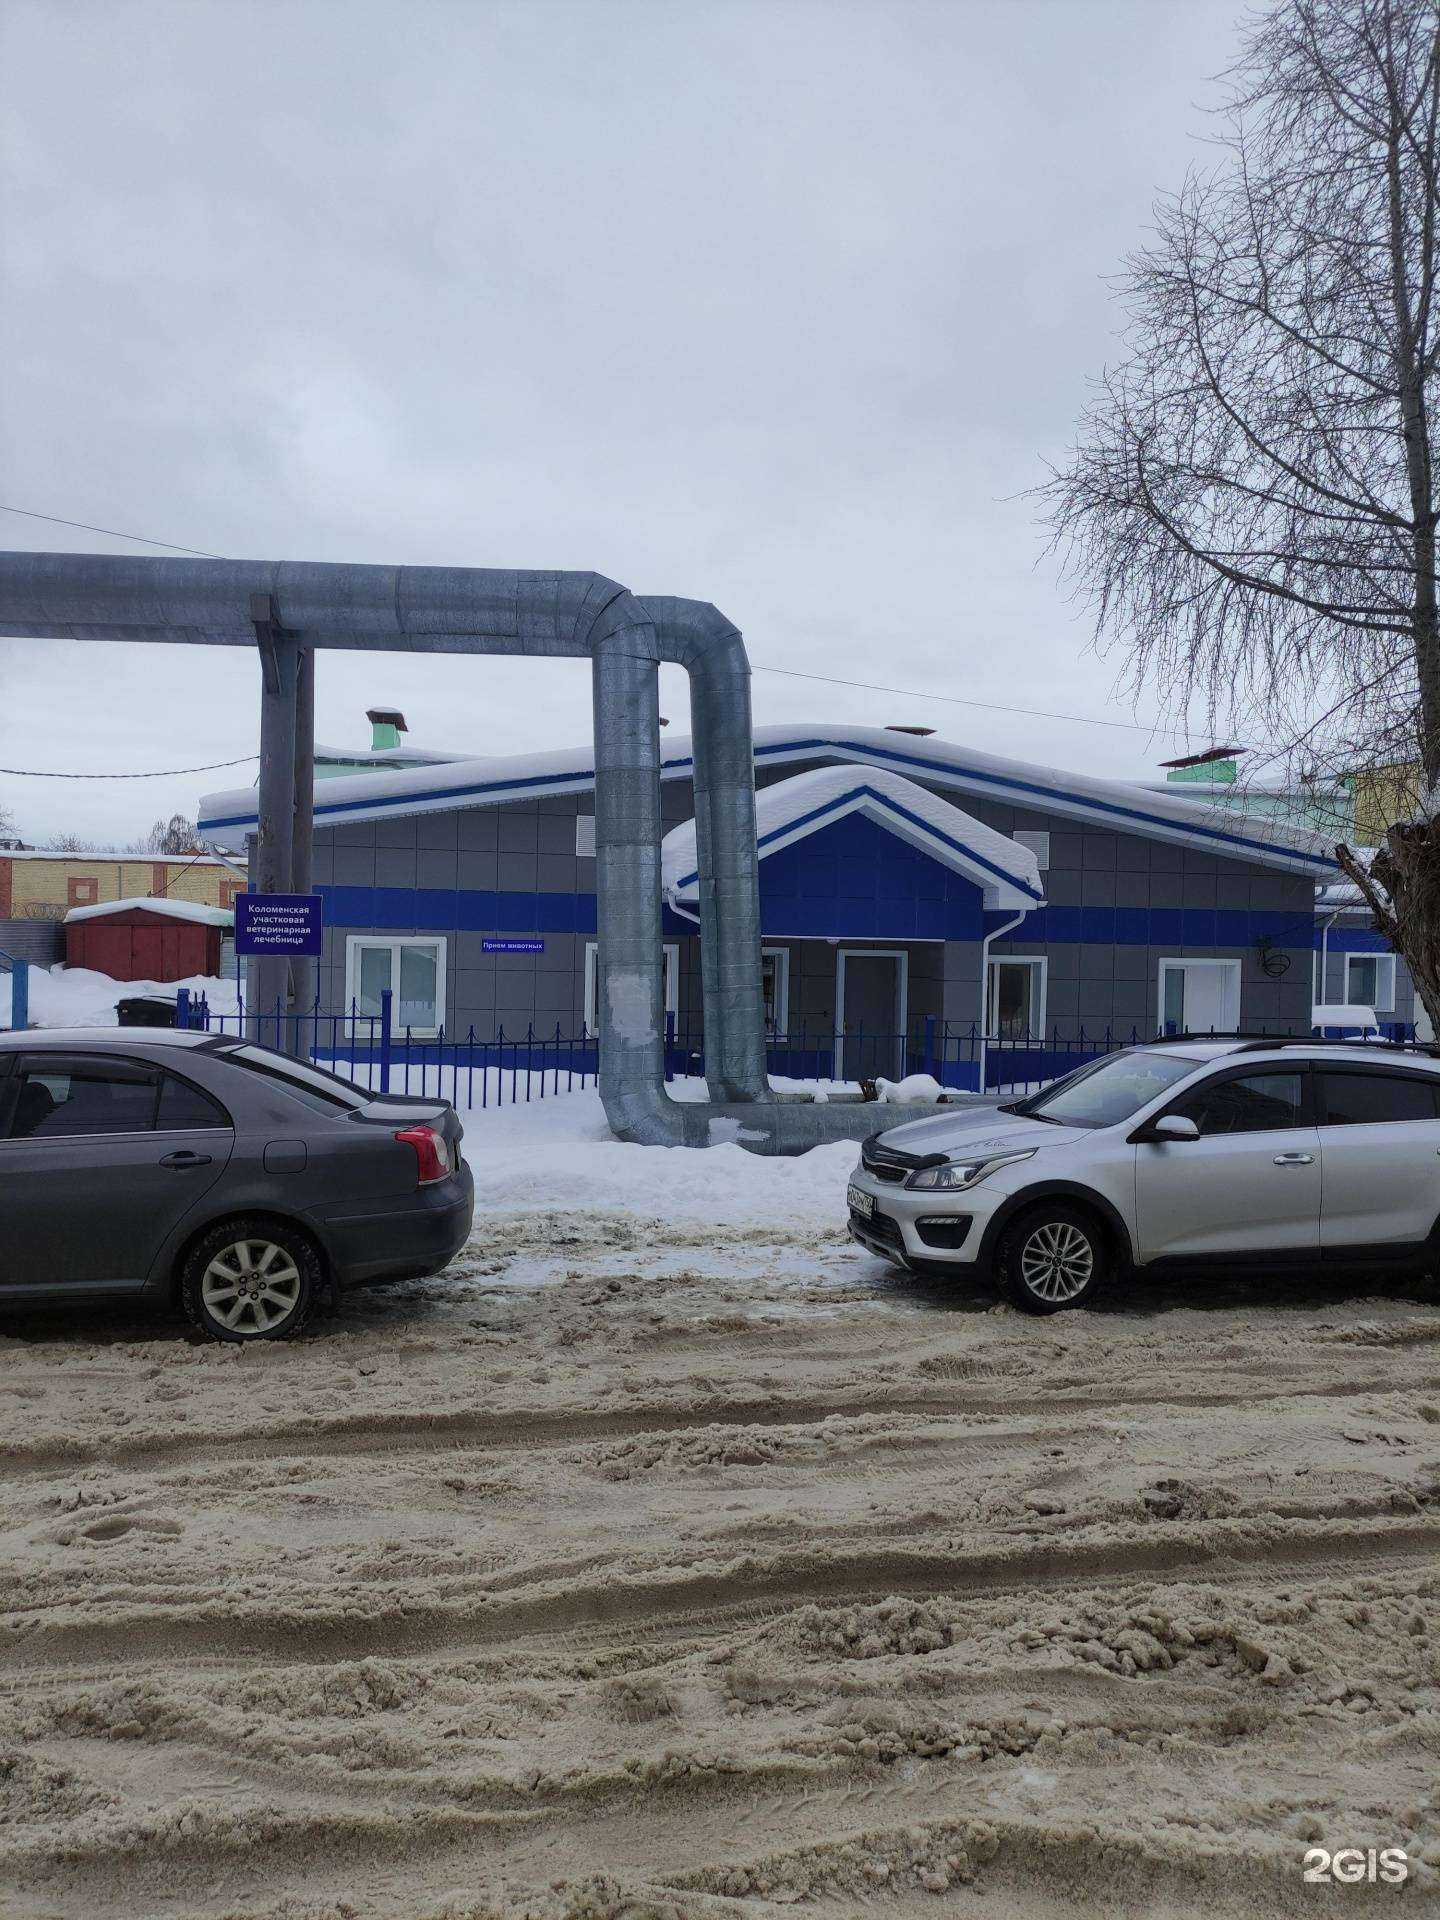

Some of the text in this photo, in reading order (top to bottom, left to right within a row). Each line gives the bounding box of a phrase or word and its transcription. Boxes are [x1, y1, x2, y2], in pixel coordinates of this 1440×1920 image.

[248, 904, 310, 914] Коломенская
[253, 916, 305, 925] участковая
[246, 926, 311, 935] ветеринарная
[253, 935, 304, 945] лечебница
